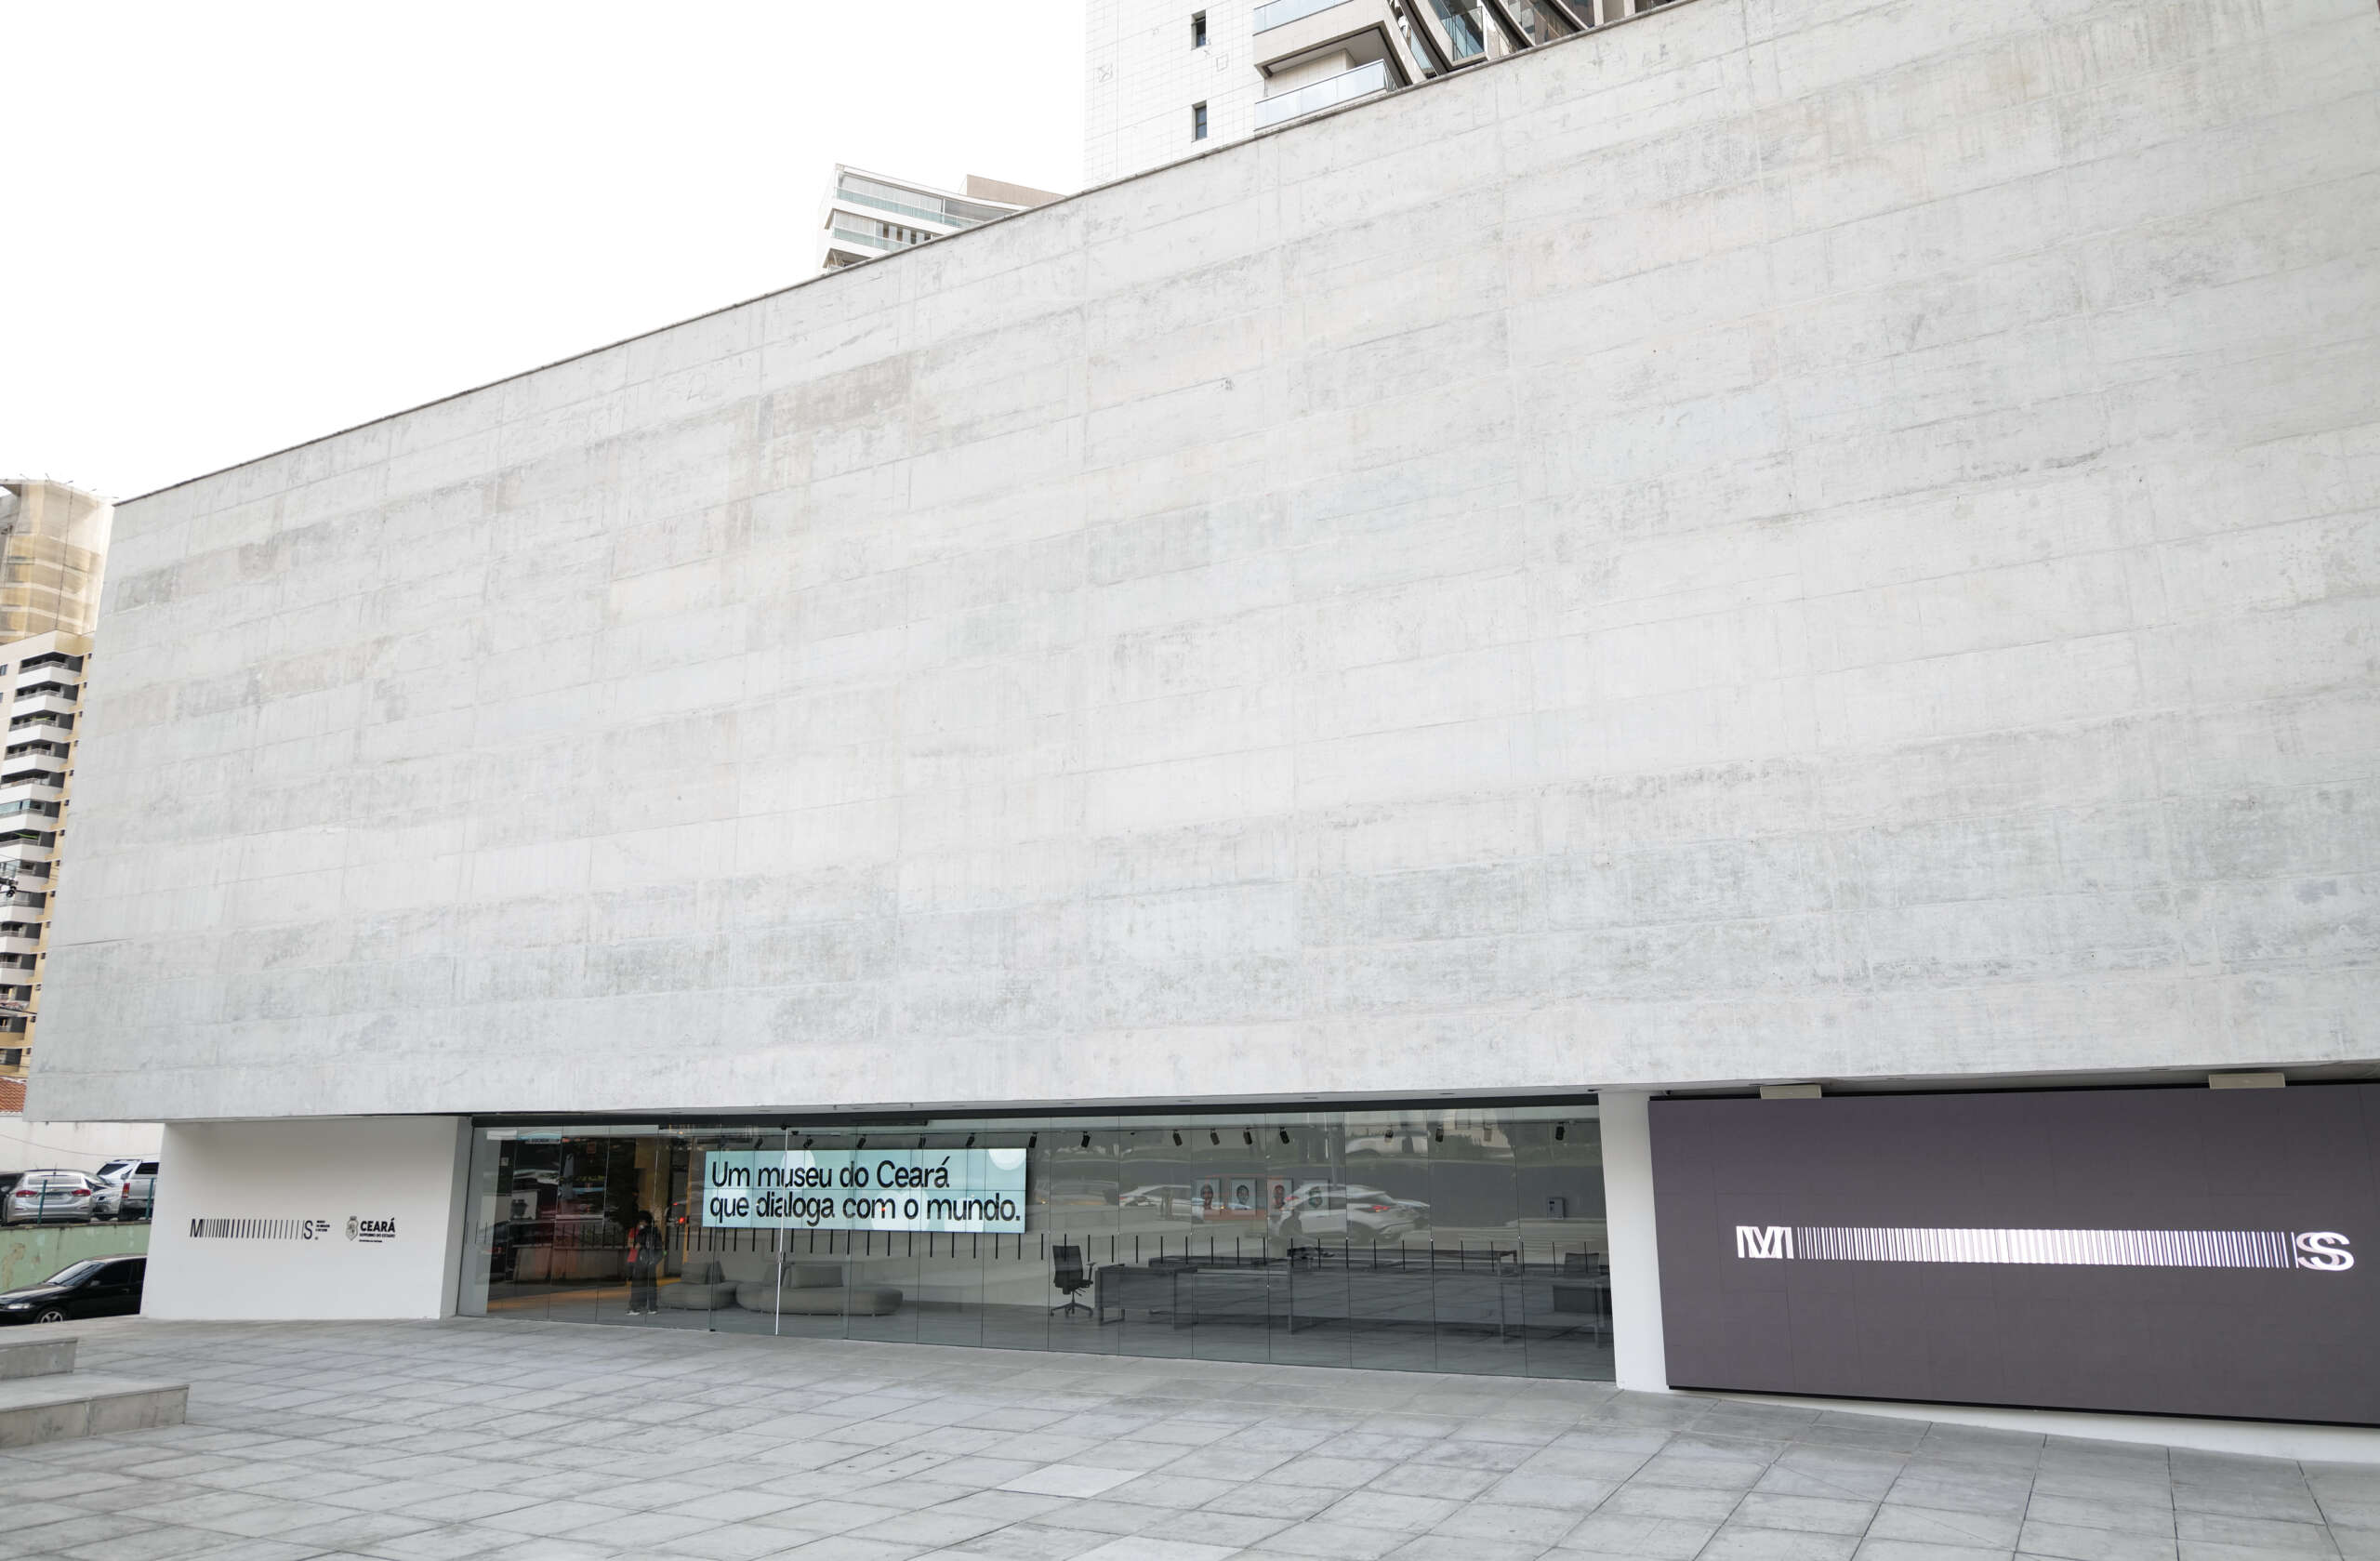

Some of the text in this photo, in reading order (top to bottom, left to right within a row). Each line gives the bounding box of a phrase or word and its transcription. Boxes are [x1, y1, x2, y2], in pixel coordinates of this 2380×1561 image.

[712, 1156, 950, 1189] Um museu do Ceará
[360, 1217, 396, 1233] CEARÁ
[709, 1191, 1021, 1227] que dialoga com o mundo.
